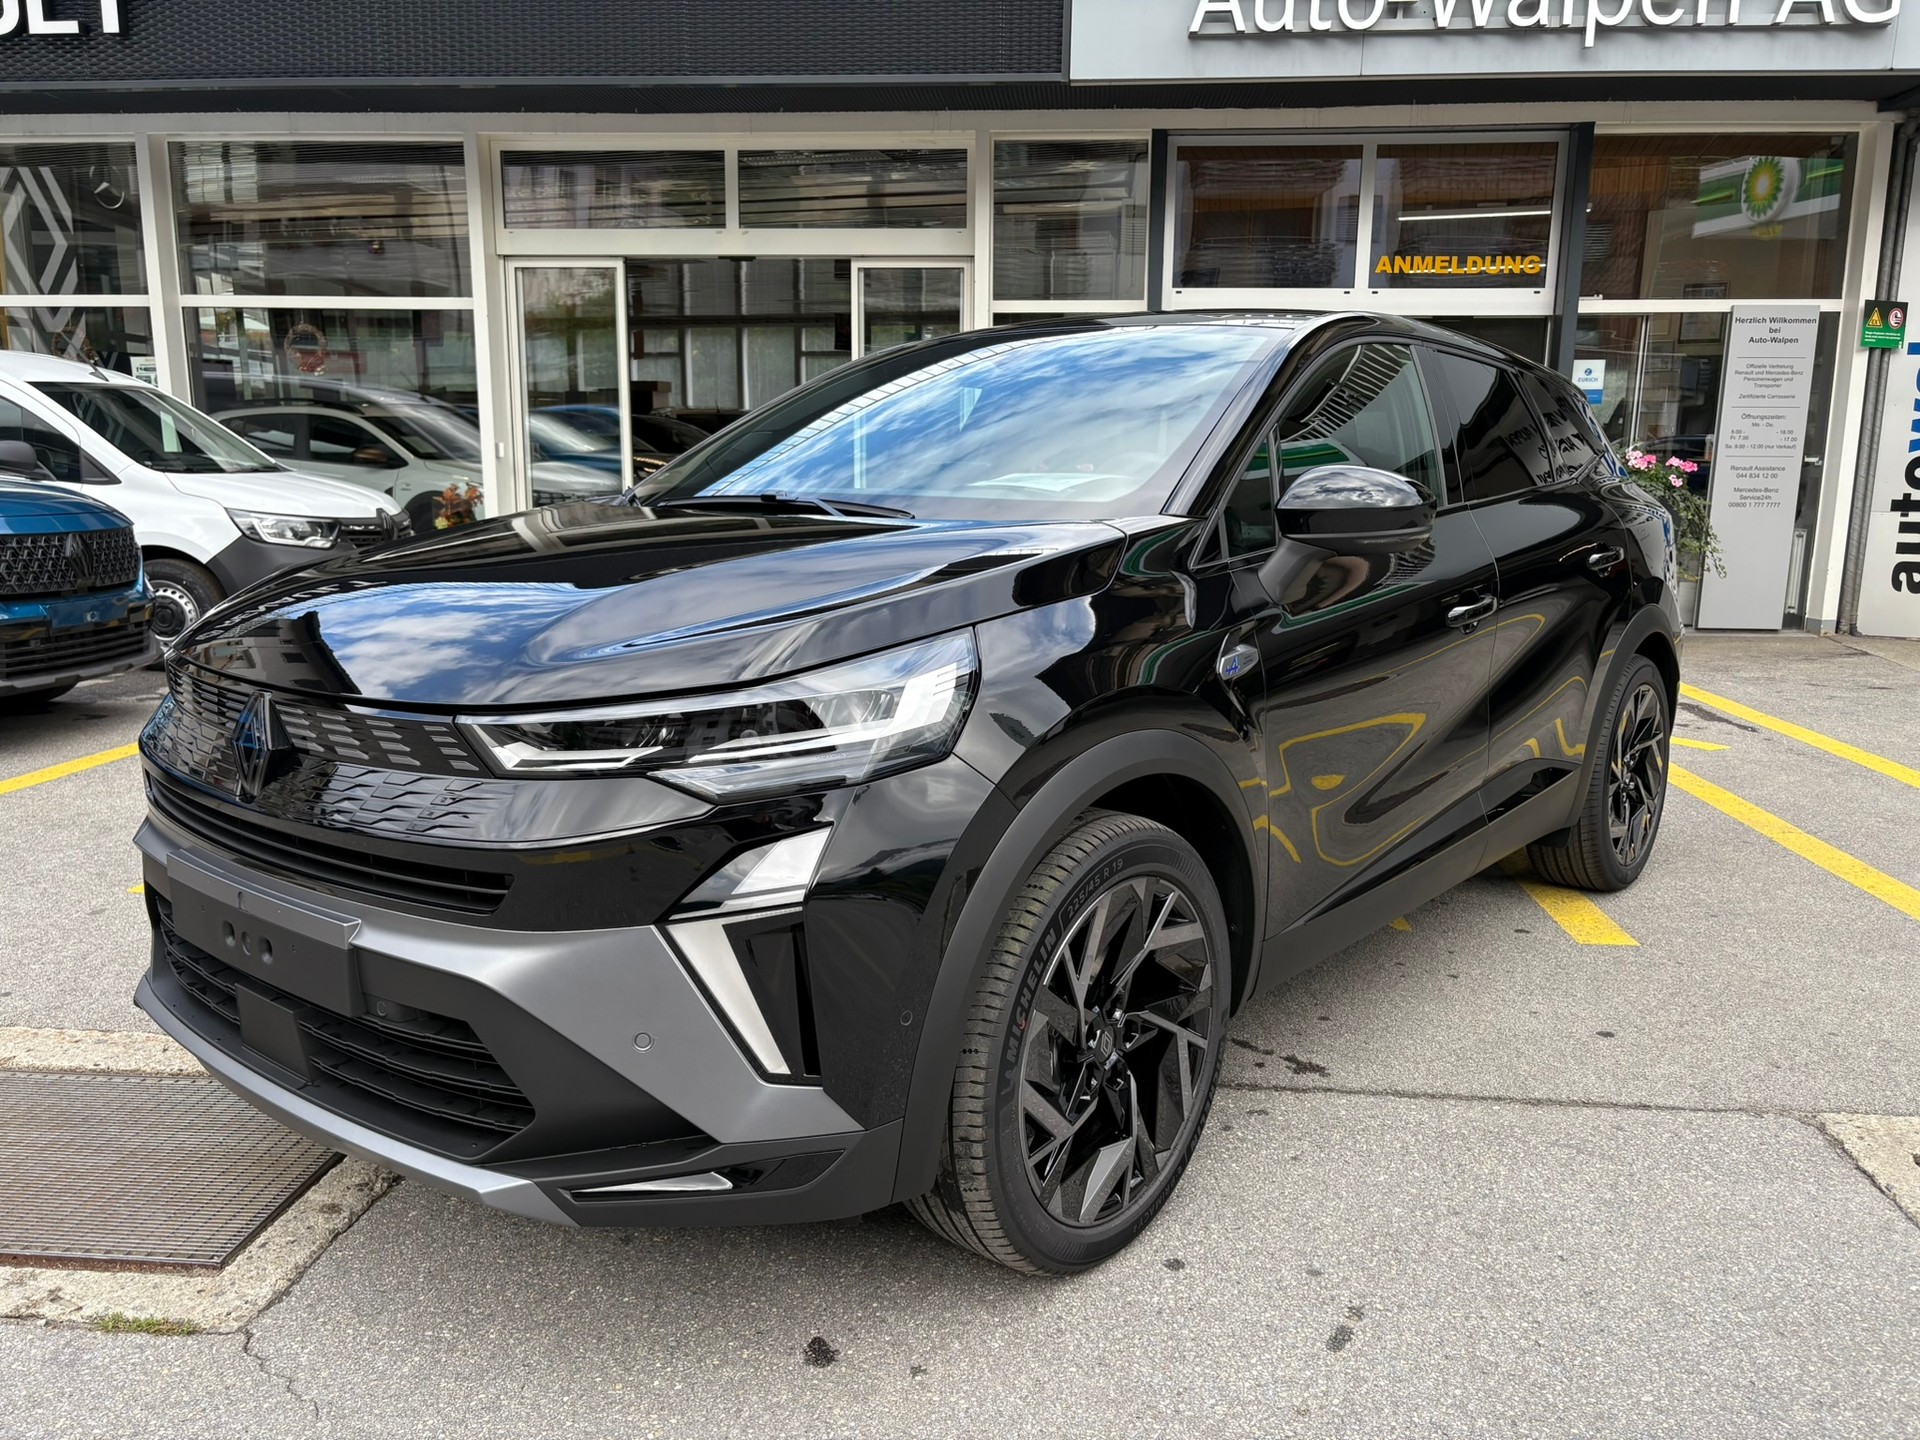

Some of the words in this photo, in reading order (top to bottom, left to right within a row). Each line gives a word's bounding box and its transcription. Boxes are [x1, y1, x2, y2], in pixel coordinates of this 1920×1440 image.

[1374, 255, 1541, 274] ANMELDUNG
[1734, 316, 1767, 324] Herzlich
[1768, 316, 1817, 324] Willkommen
[1768, 326, 1781, 334] bei
[1748, 336, 1799, 345] Auto-Walpen
[1067, 874, 1101, 918] 225/45
[1103, 867, 1110, 879] R
[1112, 858, 1123, 872] 19
[1006, 927, 1057, 1064] MICHELIN
